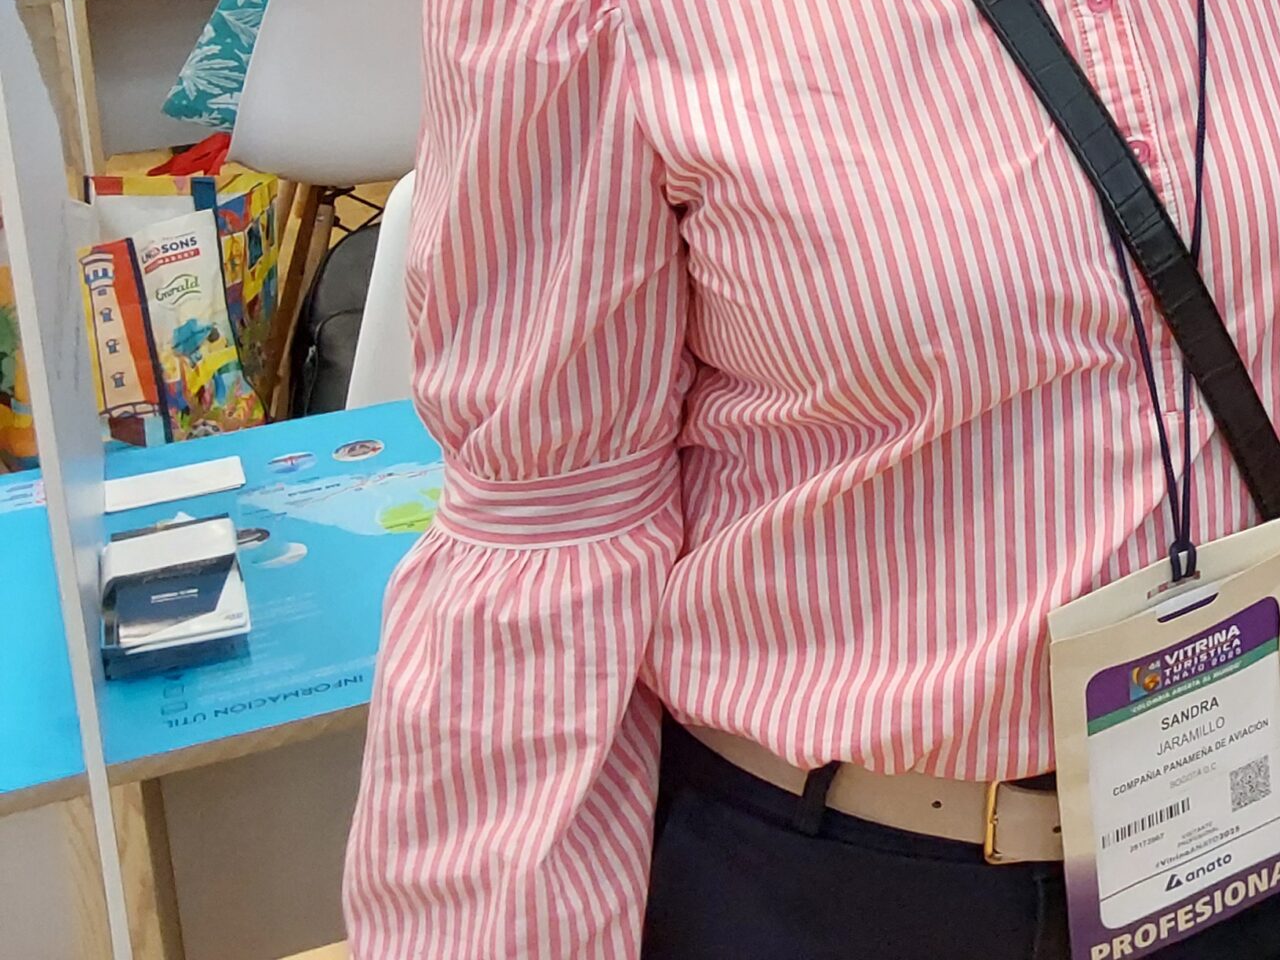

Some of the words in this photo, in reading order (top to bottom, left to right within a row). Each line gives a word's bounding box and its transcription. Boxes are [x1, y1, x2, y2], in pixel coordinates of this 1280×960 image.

[161, 236, 198, 254] SONS
[1164, 624, 1241, 665] VITRINA
[1164, 662, 1205, 686] ANATO
[1161, 696, 1220, 731] SANDRA
[1157, 716, 1226, 756] JARAMILLO
[1163, 742, 1214, 774] PANAMEÑA
[1215, 738, 1227, 751] DE
[1228, 718, 1270, 744] AVIACIÓN
[1185, 853, 1233, 883] anato
